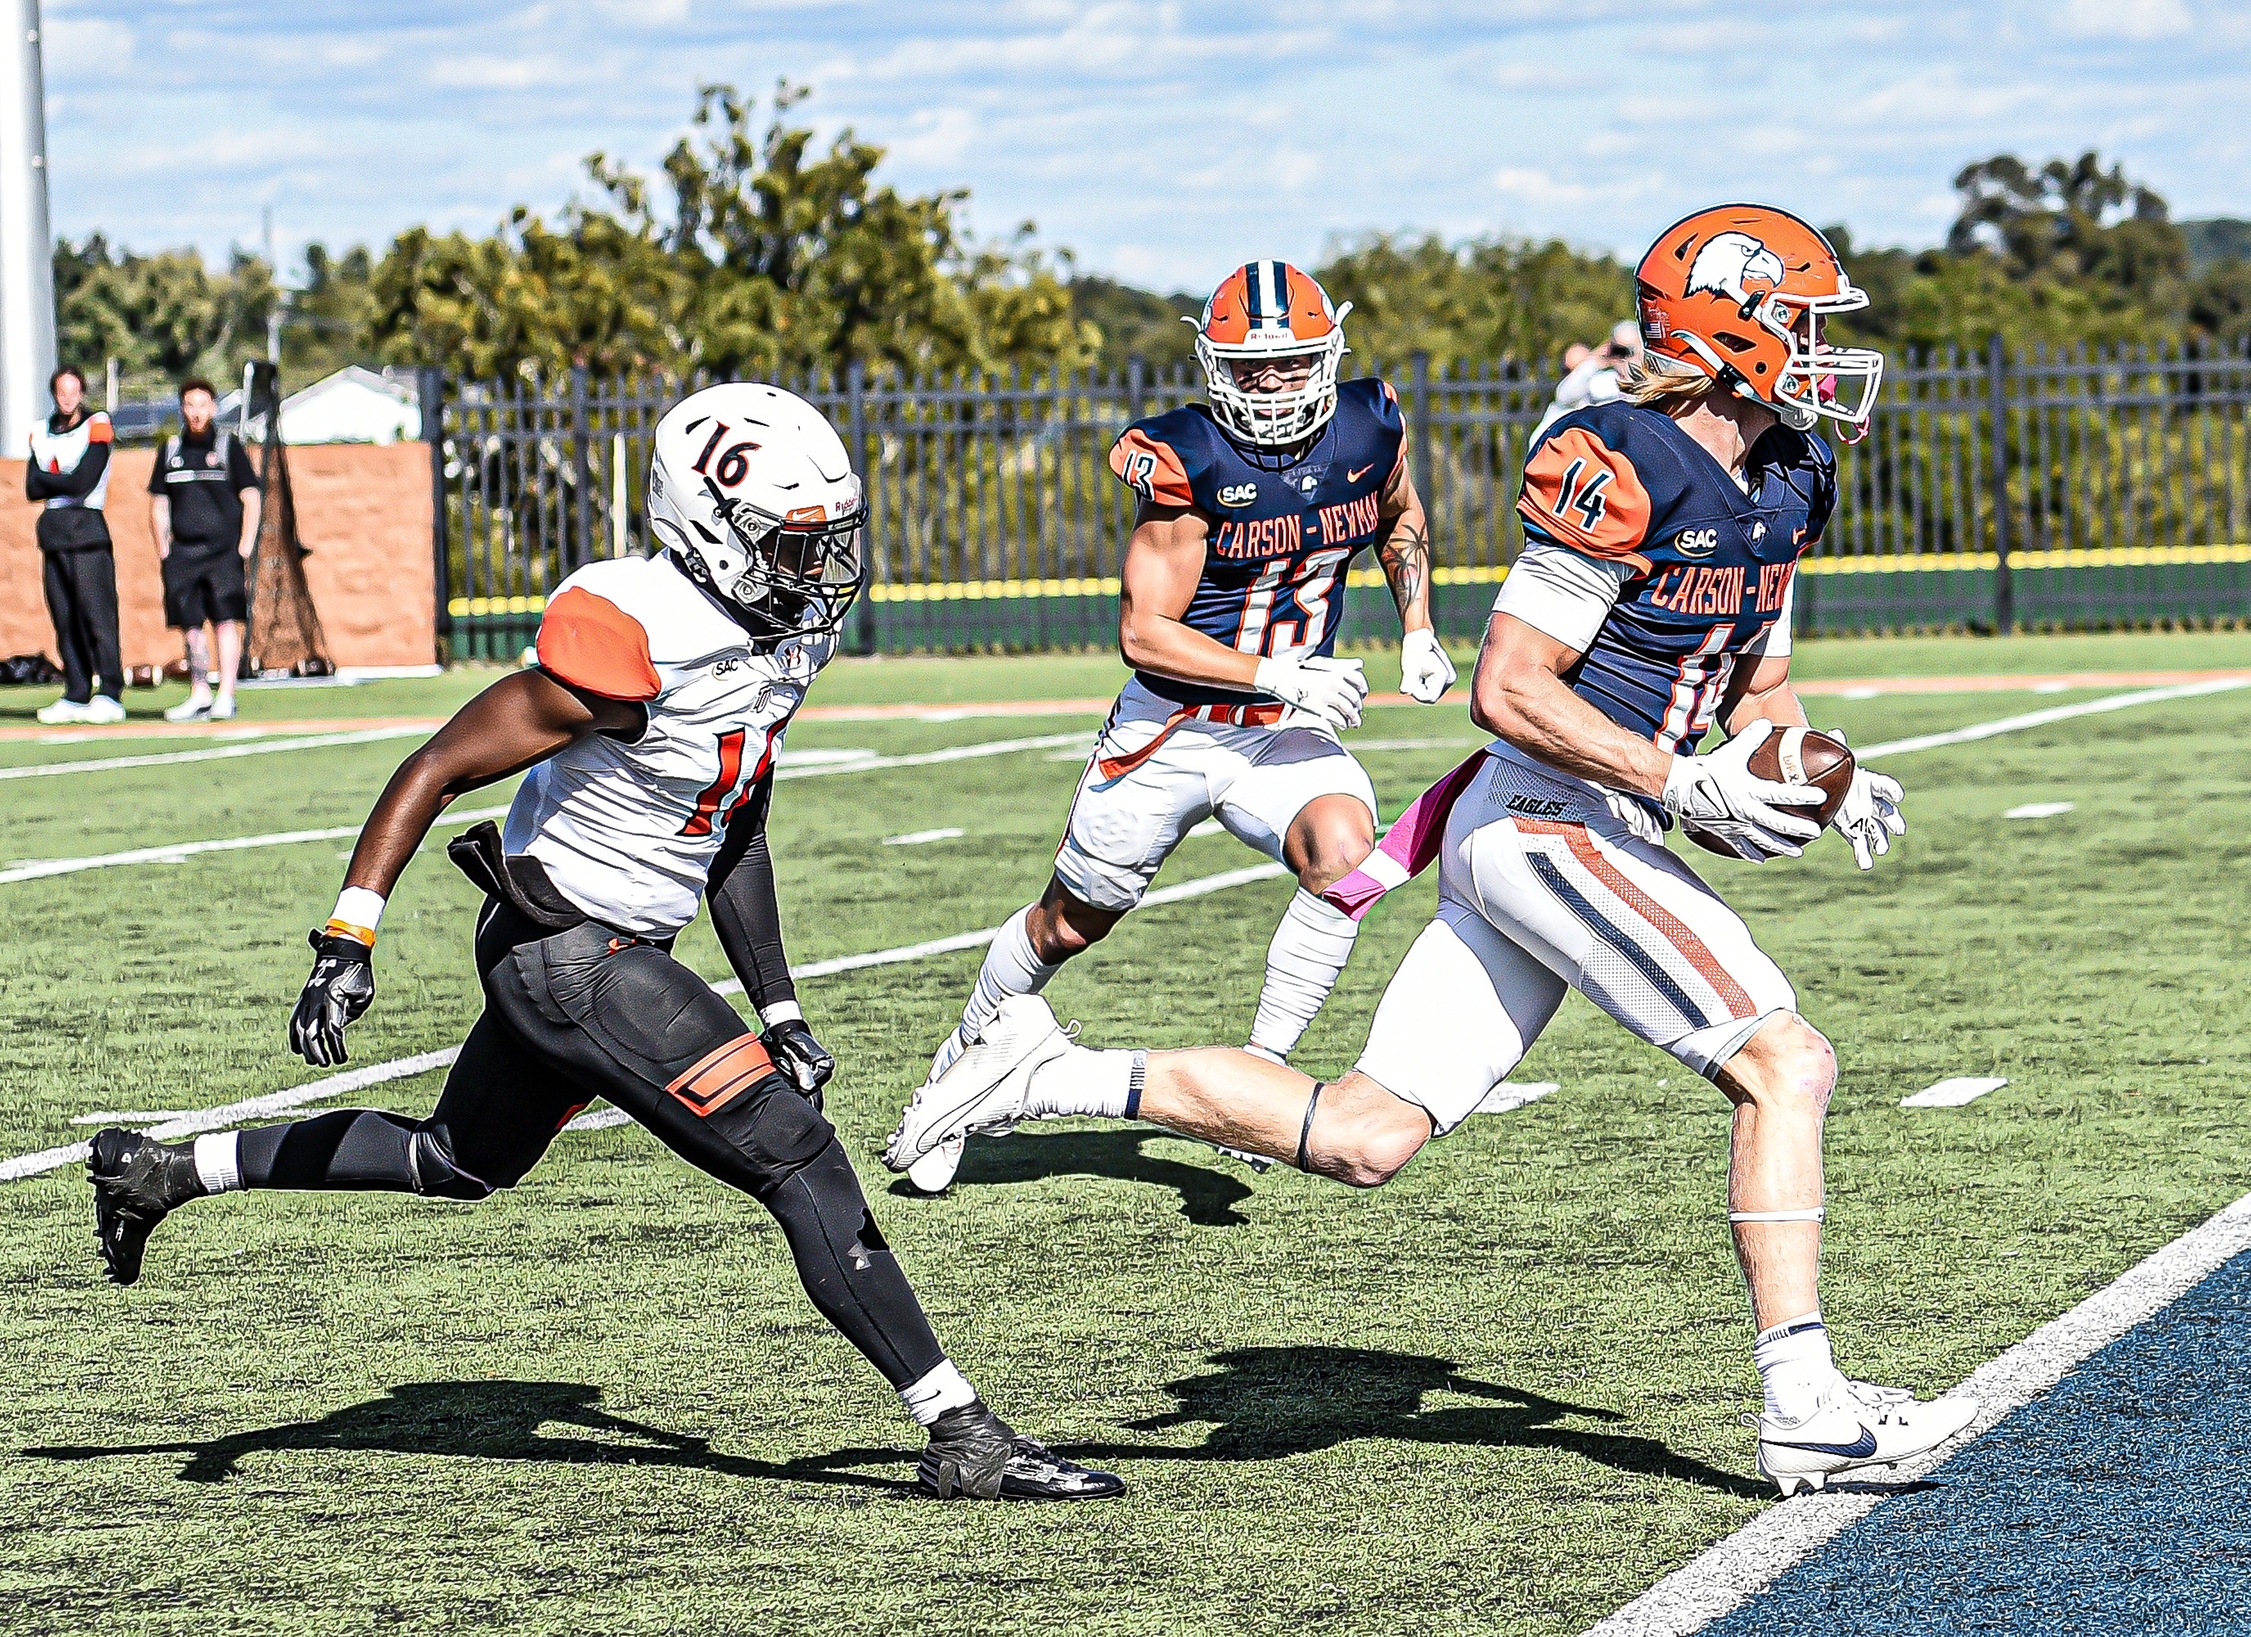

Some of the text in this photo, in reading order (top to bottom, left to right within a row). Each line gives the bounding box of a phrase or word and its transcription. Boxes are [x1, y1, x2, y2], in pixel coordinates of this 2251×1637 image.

[691, 420, 762, 488] 16
[1121, 449, 1157, 501] 13
[1223, 483, 1258, 501] SAC
[1552, 456, 1616, 533] 14
[1216, 514, 1300, 558] CARSON
[1680, 528, 1718, 549] SAC
[1234, 546, 1353, 662] 13
[1651, 564, 1745, 615] CARSON
[715, 658, 739, 676] SAC
[1505, 794, 1567, 816] EAGLES
